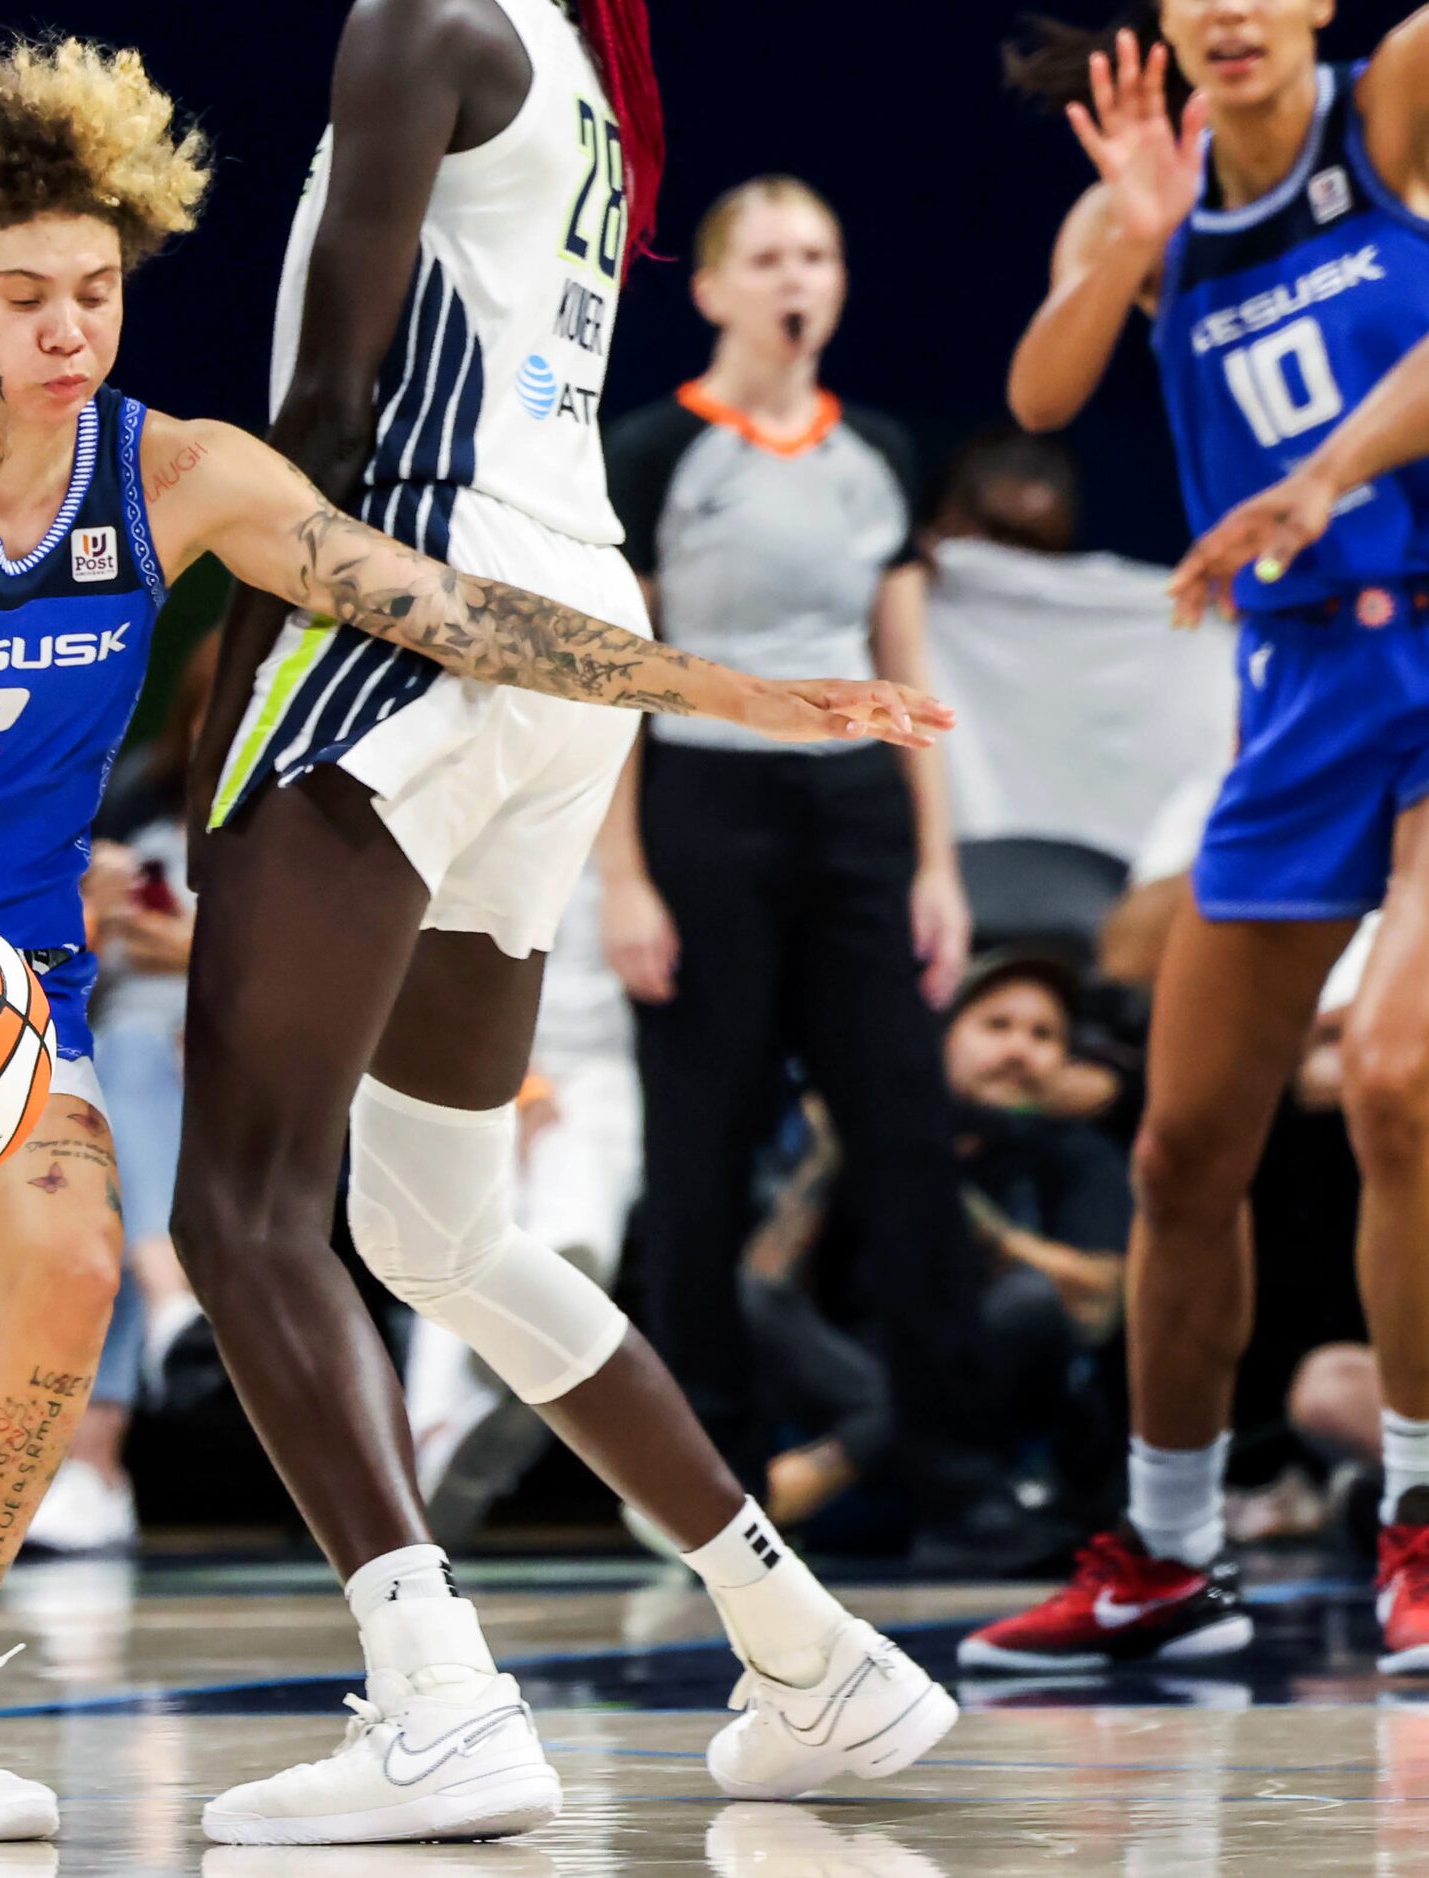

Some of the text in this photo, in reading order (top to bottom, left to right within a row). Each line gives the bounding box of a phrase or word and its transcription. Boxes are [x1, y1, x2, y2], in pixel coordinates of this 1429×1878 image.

[562, 97, 623, 281] 28
[557, 382, 599, 424] AT
[1223, 316, 1342, 448] 10
[75, 554, 115, 572] Post
